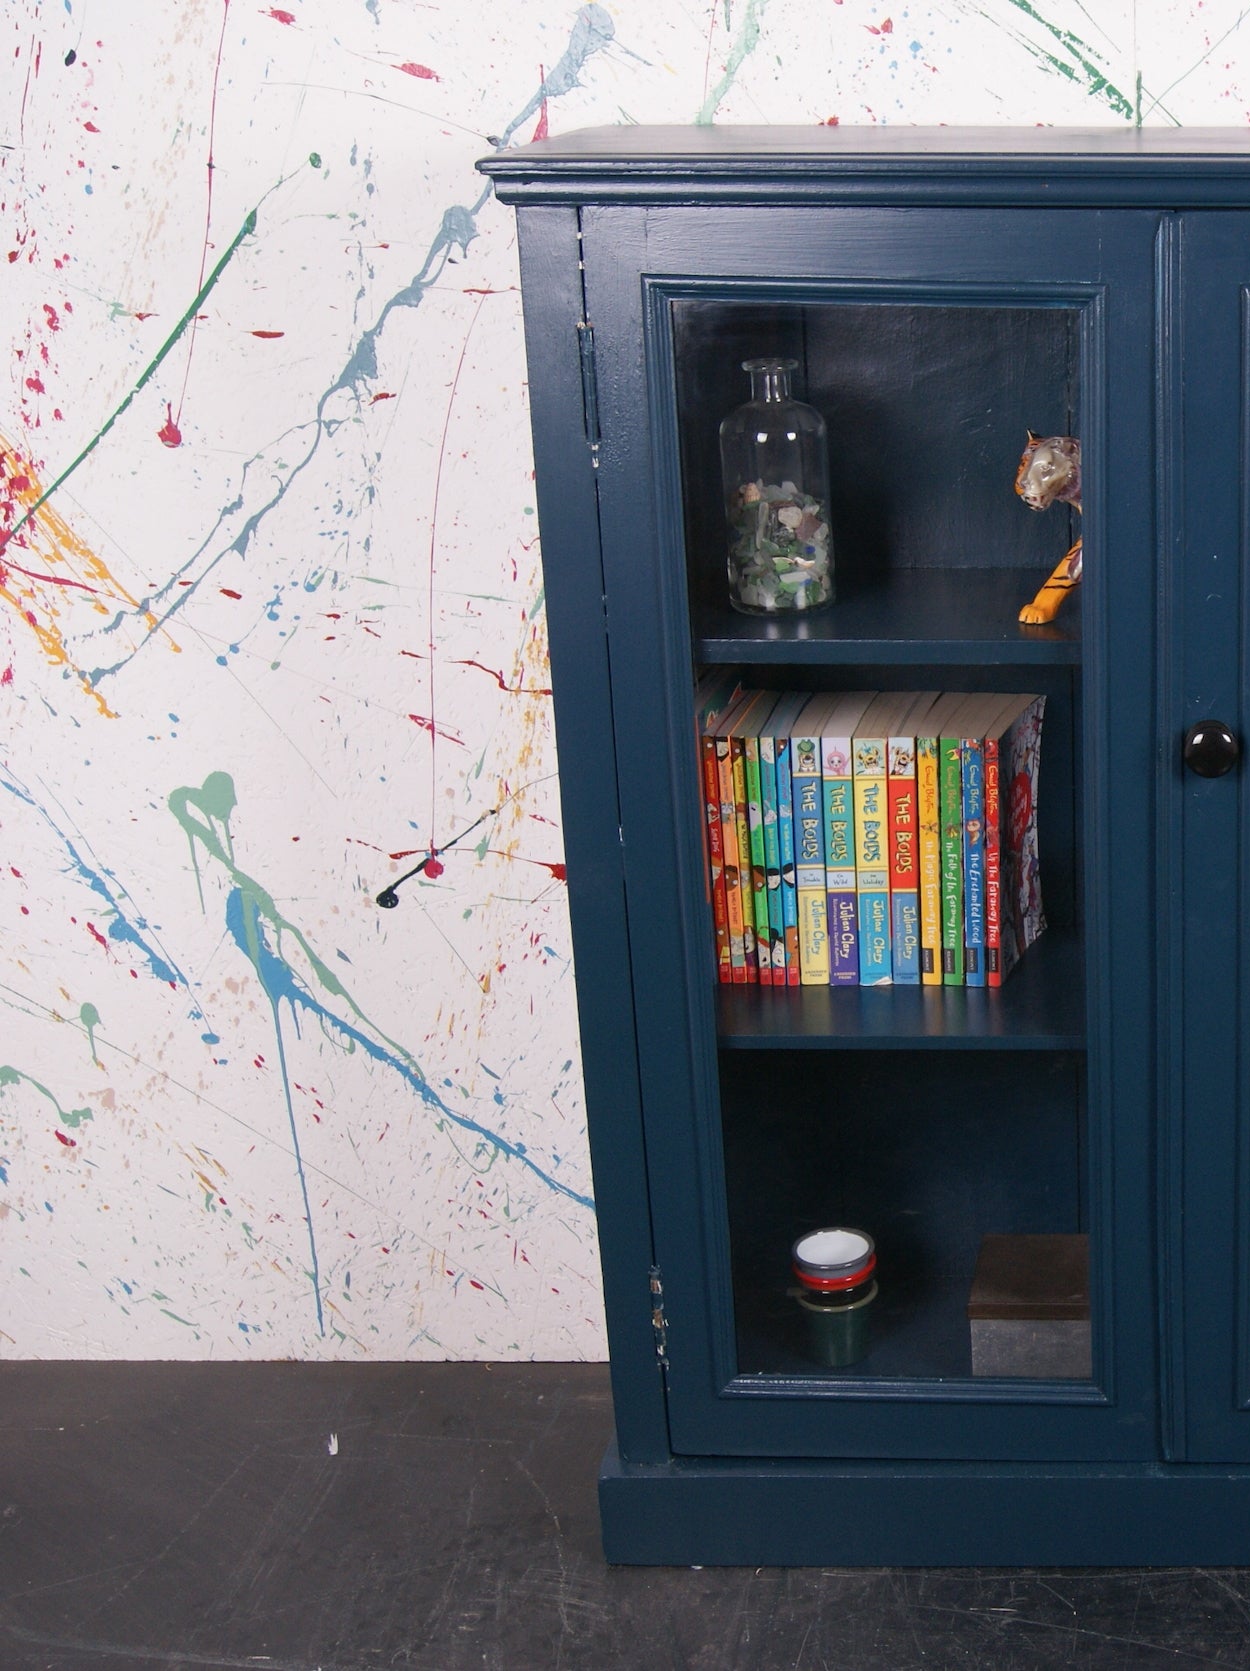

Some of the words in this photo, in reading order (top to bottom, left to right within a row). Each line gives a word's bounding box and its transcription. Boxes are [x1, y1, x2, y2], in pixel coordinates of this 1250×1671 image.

[801, 782, 817, 812] THE
[831, 785, 847, 814] THE
[863, 784, 879, 814] THE
[895, 793, 911, 825] THE
[801, 818, 819, 860] BOLDS
[831, 821, 848, 862] BOLDS
[863, 821, 881, 862] BOLDS
[895, 831, 913, 874] BOLDS
[947, 854, 958, 871] Folk
[971, 852, 981, 868] The
[988, 852, 999, 862] Up
[945, 872, 956, 881] of
[969, 869, 981, 917] Enchanted
[987, 881, 999, 921] Faraway
[811, 900, 826, 929] Julian
[839, 902, 855, 931] Julian
[872, 900, 885, 933] Julian
[903, 906, 917, 934] Julian
[946, 894, 957, 927] Faraway
[811, 930, 825, 955] Clary
[840, 932, 854, 958] Clary
[927, 926, 937, 944] Tree
[948, 929, 957, 947] Tree
[971, 919, 981, 943] Wood
[989, 925, 998, 943] Tree
[872, 937, 885, 964] Clary
[903, 935, 917, 960] Clary
